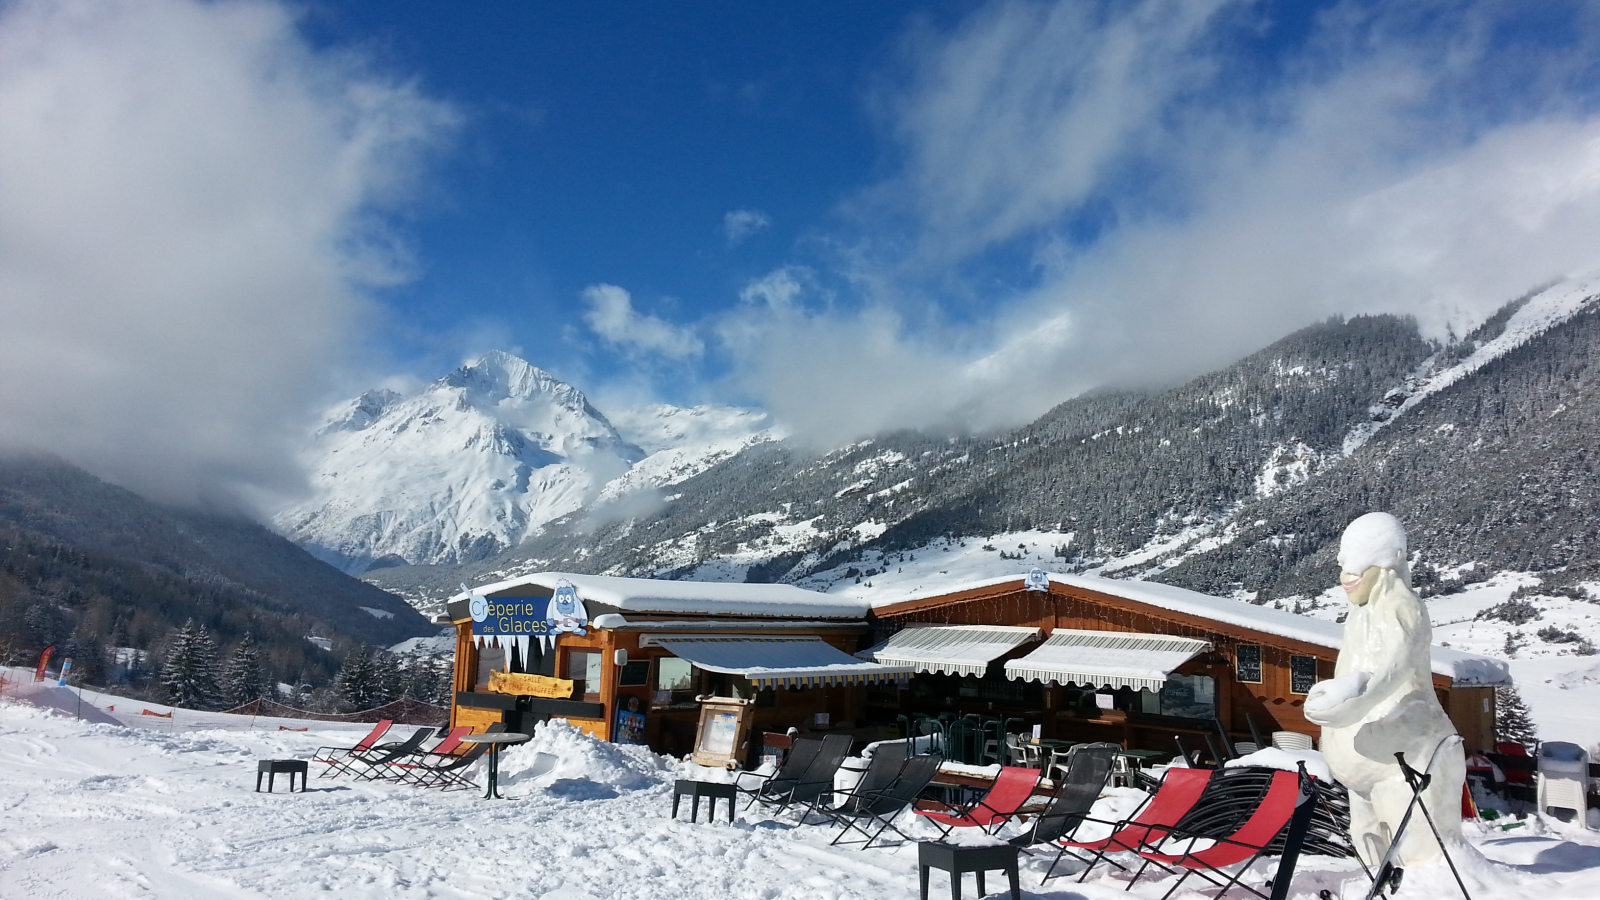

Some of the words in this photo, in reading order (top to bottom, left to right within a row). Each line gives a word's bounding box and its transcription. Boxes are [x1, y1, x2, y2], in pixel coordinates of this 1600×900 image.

[471, 600, 534, 618] Crêperie
[483, 625, 495, 633] des
[499, 617, 548, 633] Glaces
[523, 675, 541, 684] SALLE
